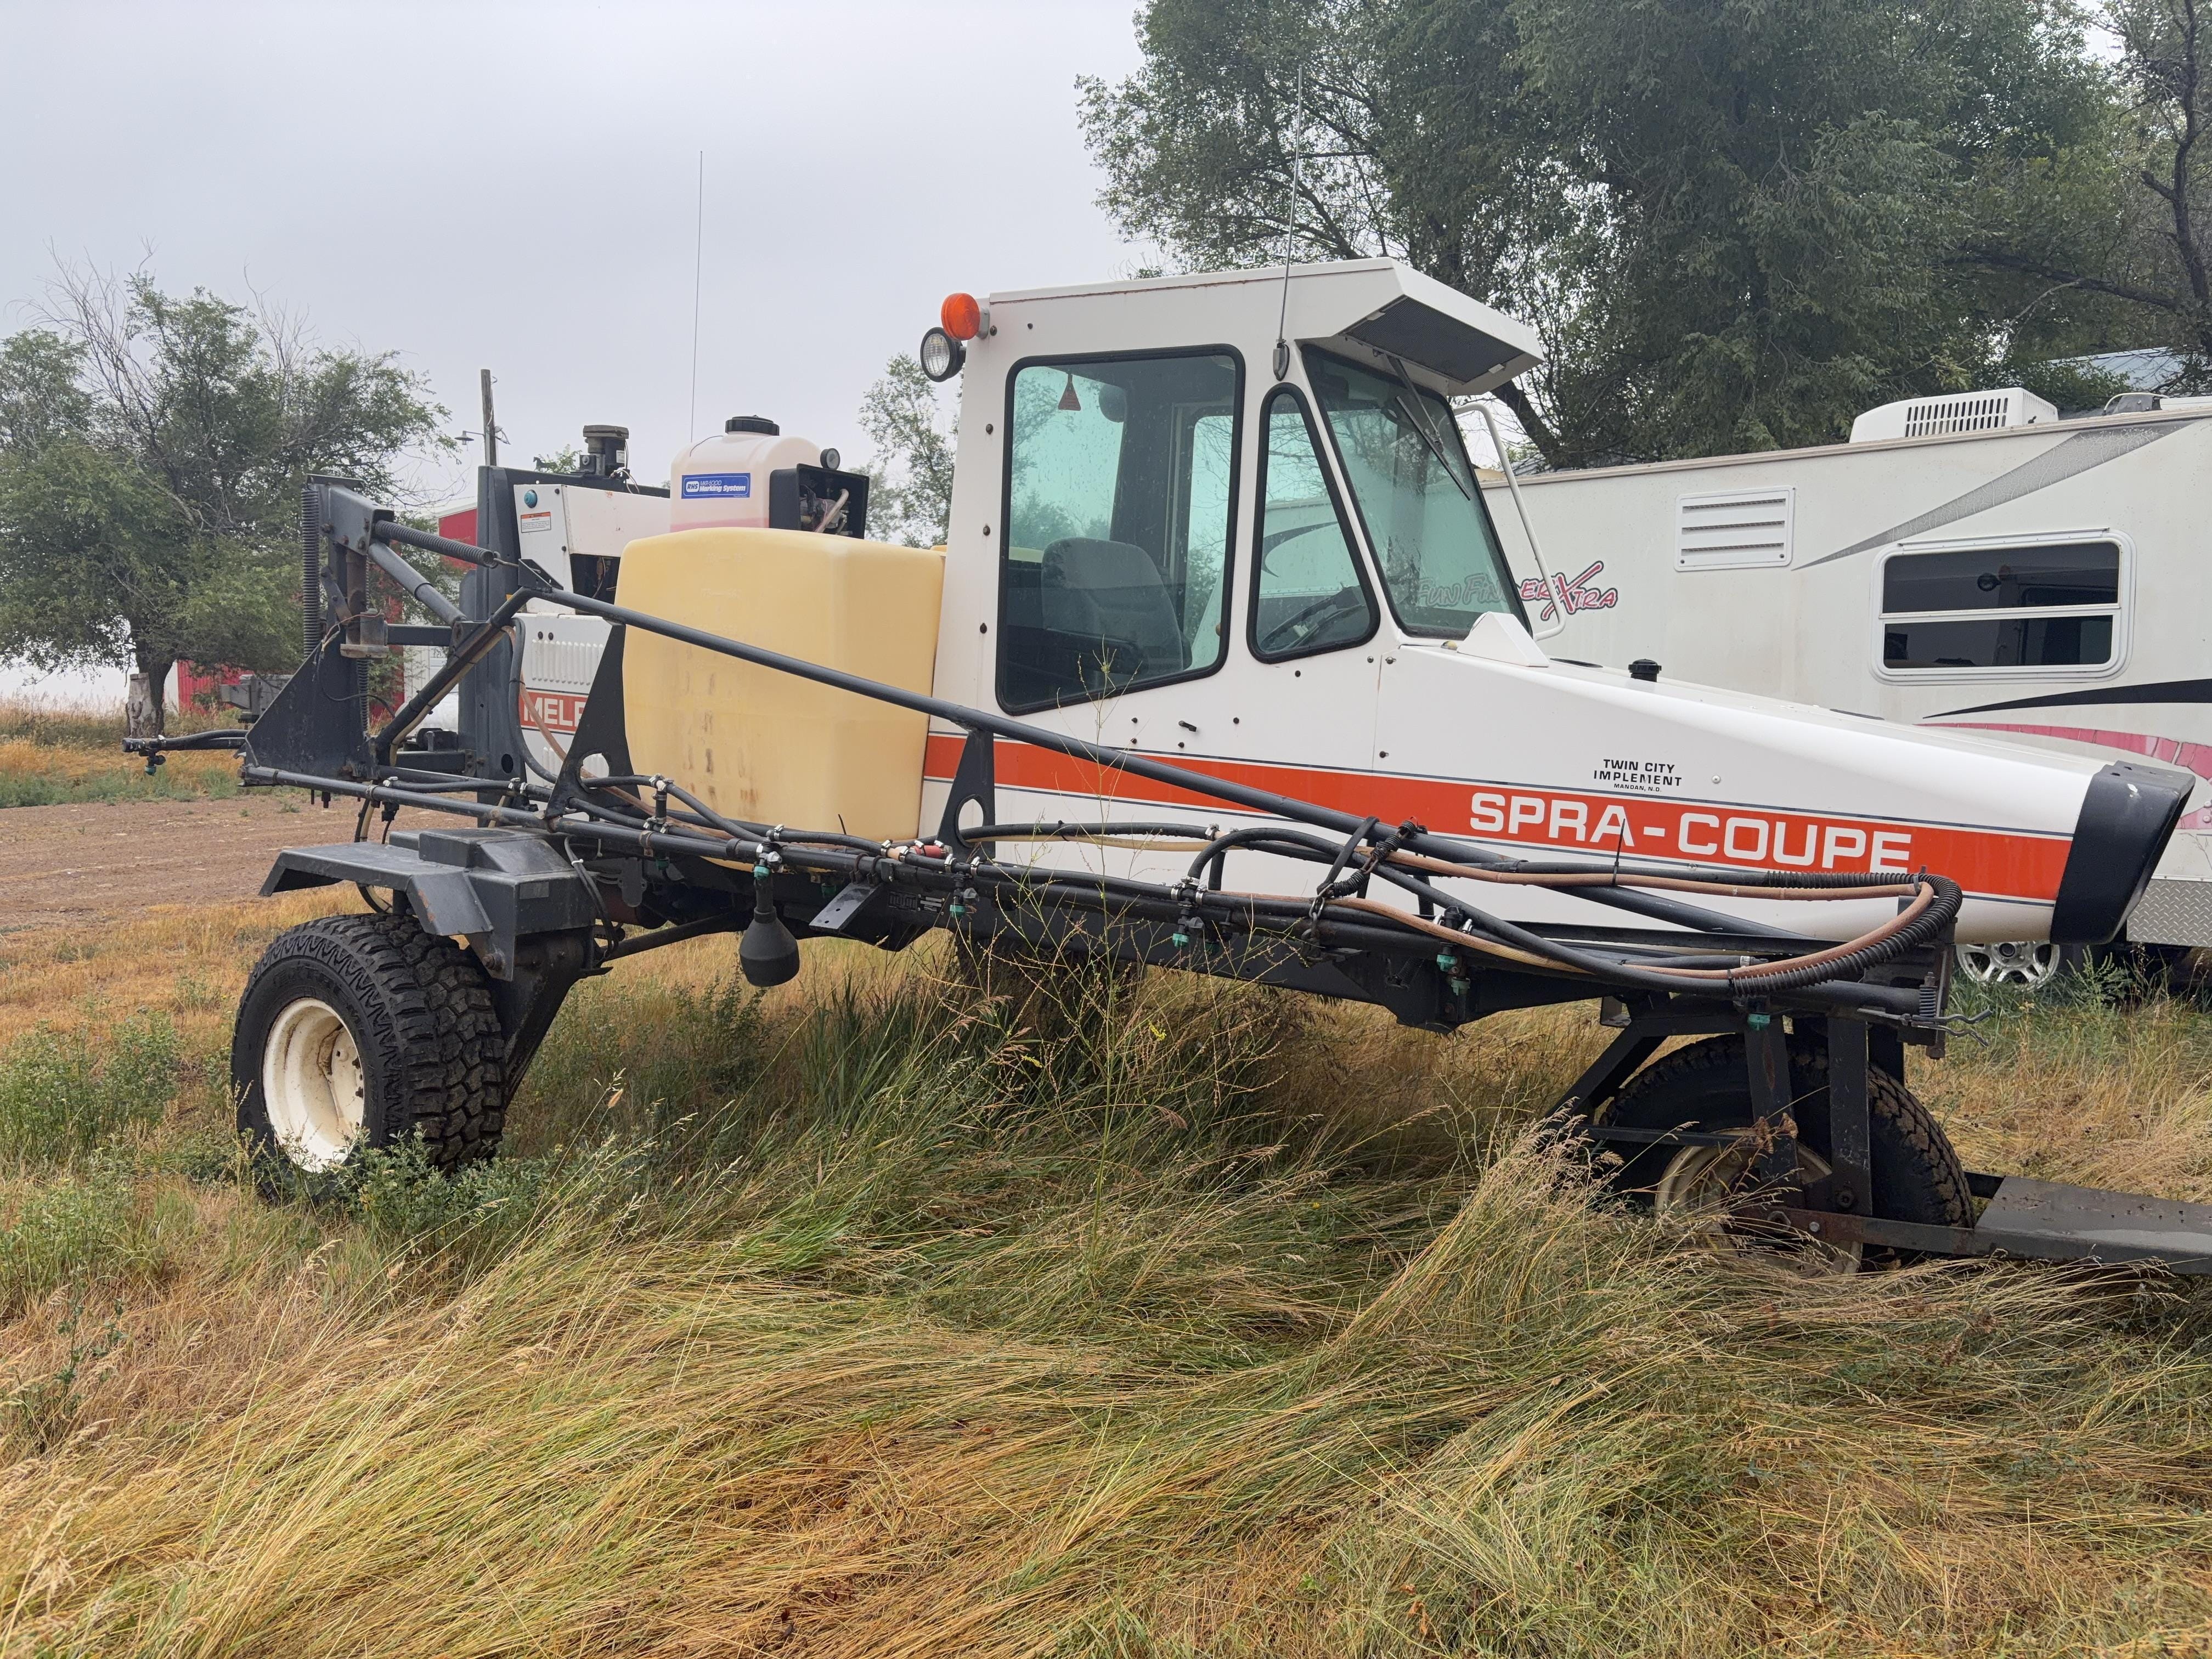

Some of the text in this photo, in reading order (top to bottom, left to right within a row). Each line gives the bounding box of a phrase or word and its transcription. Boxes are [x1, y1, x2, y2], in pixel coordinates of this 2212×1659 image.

[1604, 759, 1675, 774] TWIN CITY
[1594, 770, 1682, 786] IMPLEMENT
[1614, 783, 1646, 792] MANDAN,
